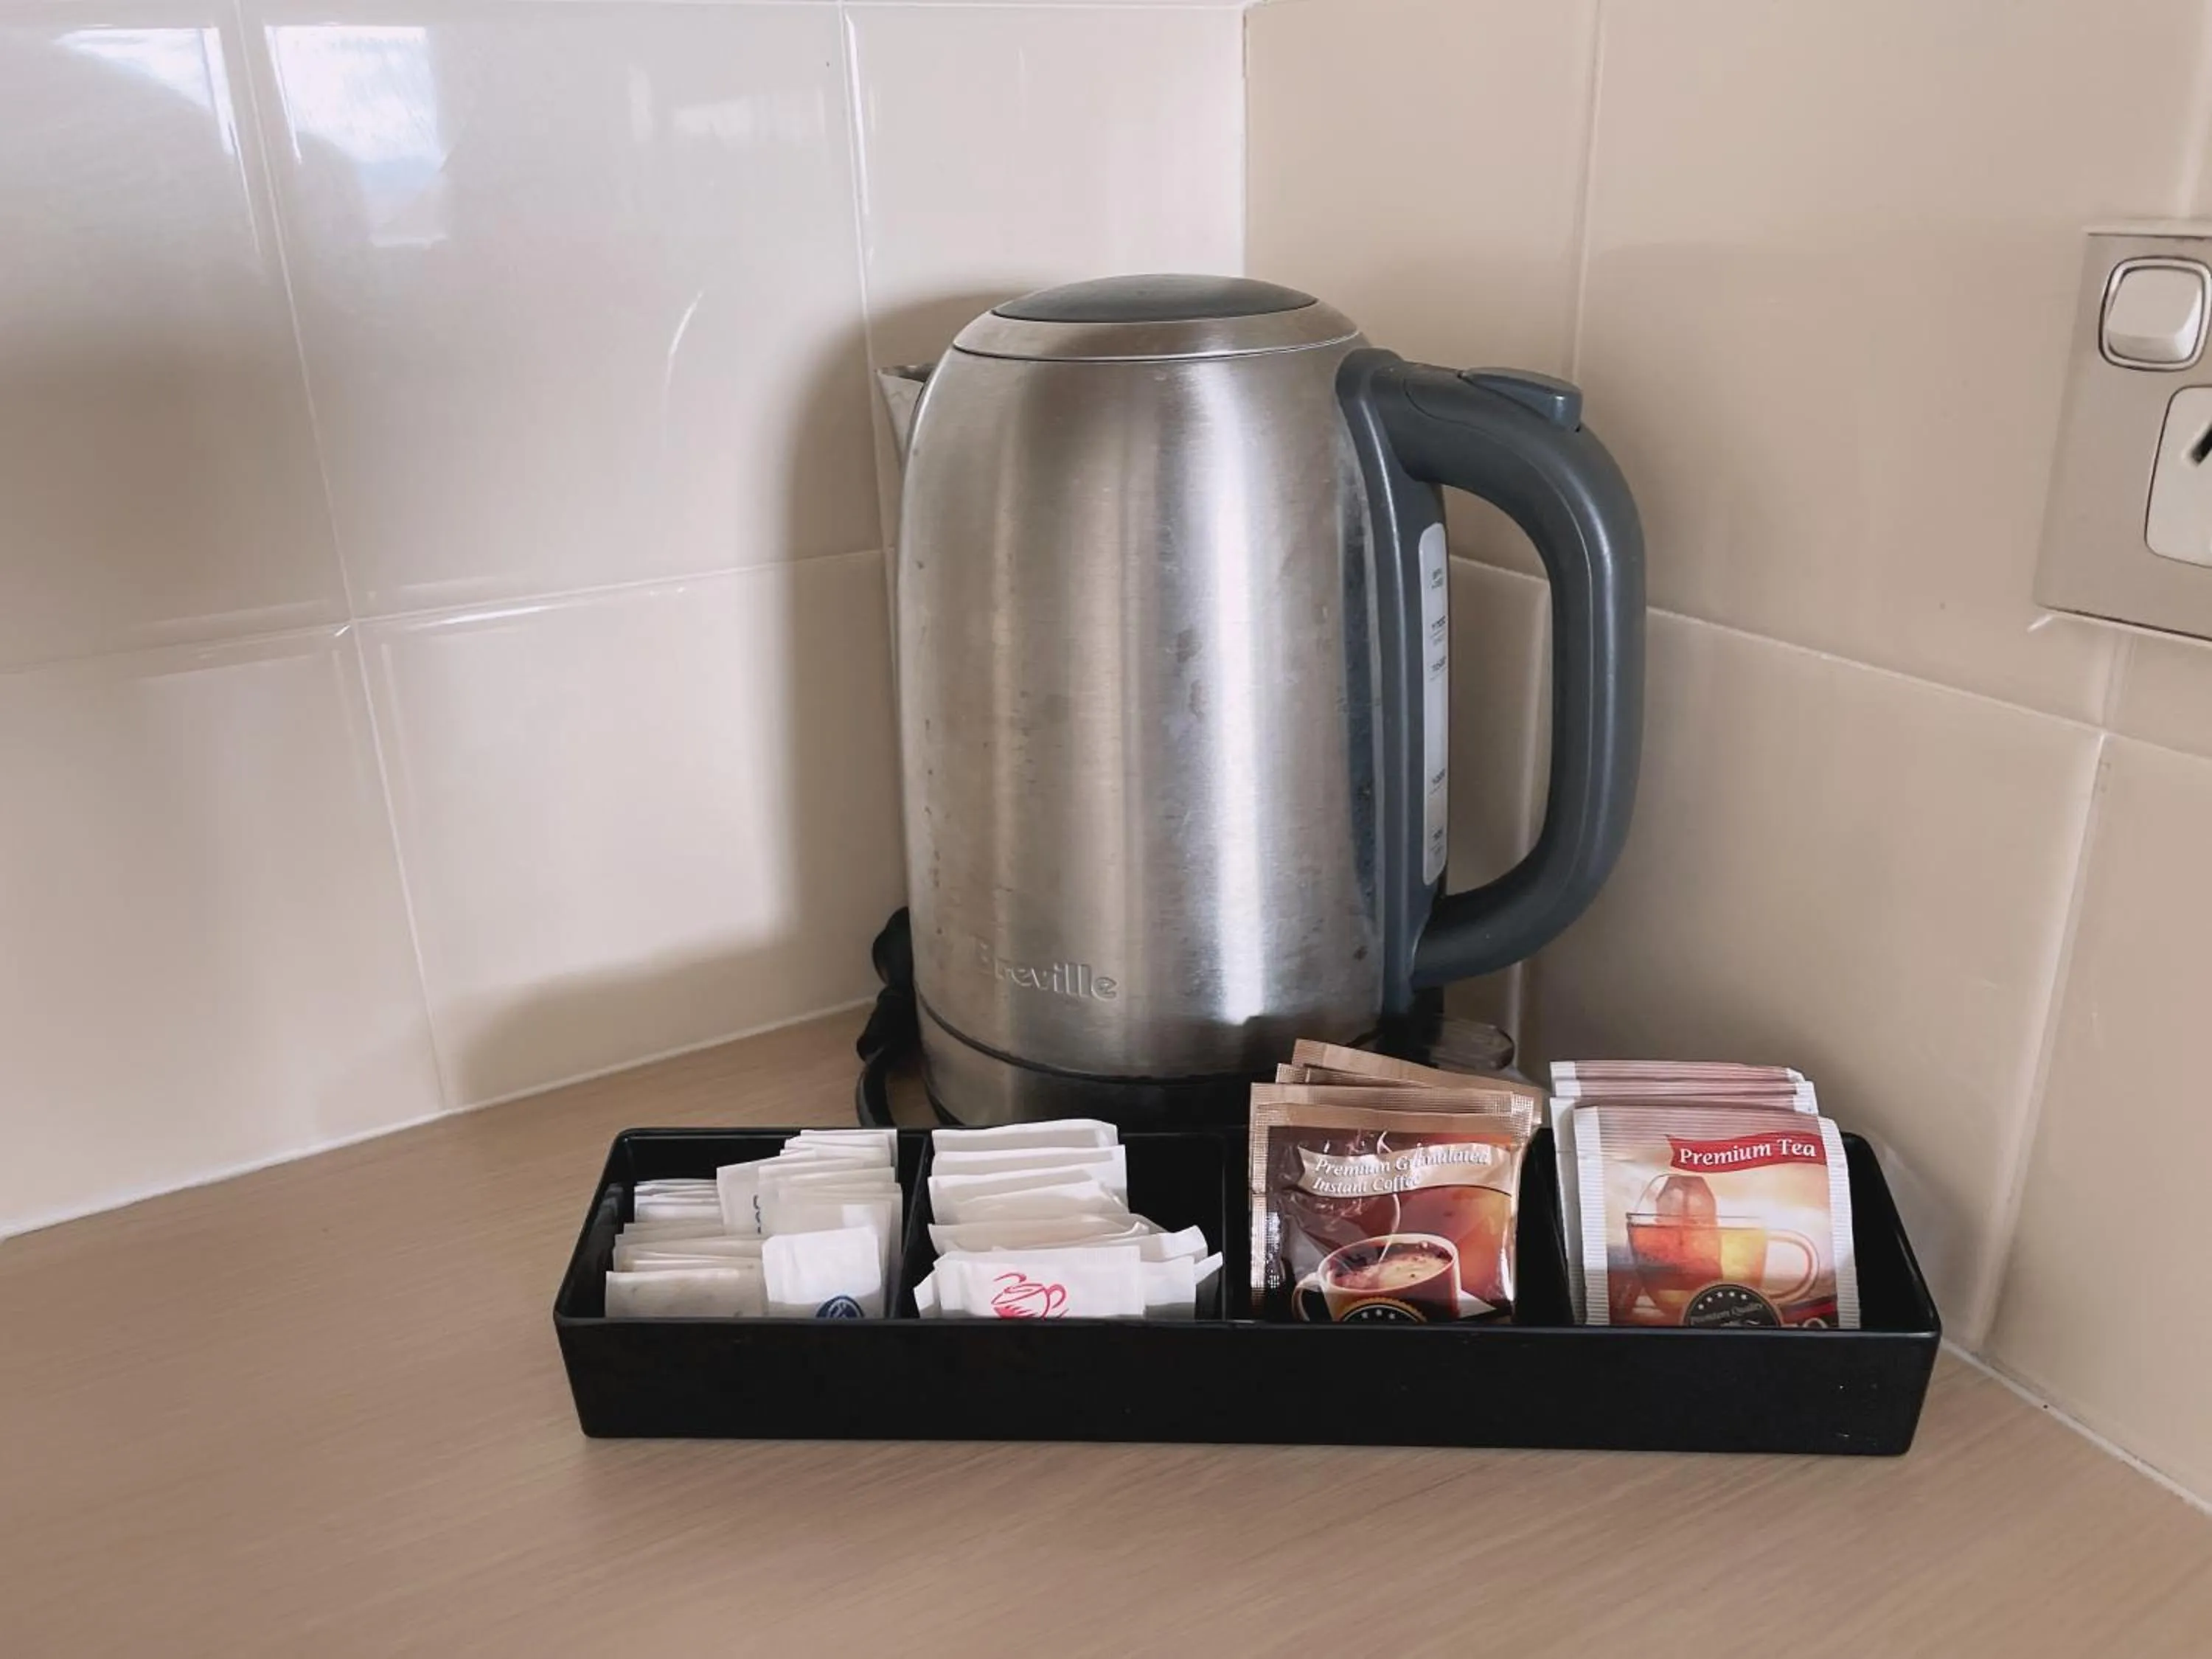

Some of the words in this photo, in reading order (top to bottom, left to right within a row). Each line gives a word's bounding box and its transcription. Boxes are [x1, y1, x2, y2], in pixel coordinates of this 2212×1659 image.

[1680, 1144, 1772, 1166] Premium
[1776, 1138, 1817, 1157] Tea
[1315, 1156, 1391, 1178] Premium
[1312, 1178, 1367, 1194] Instant
[1371, 1172, 1422, 1192] Coffee
